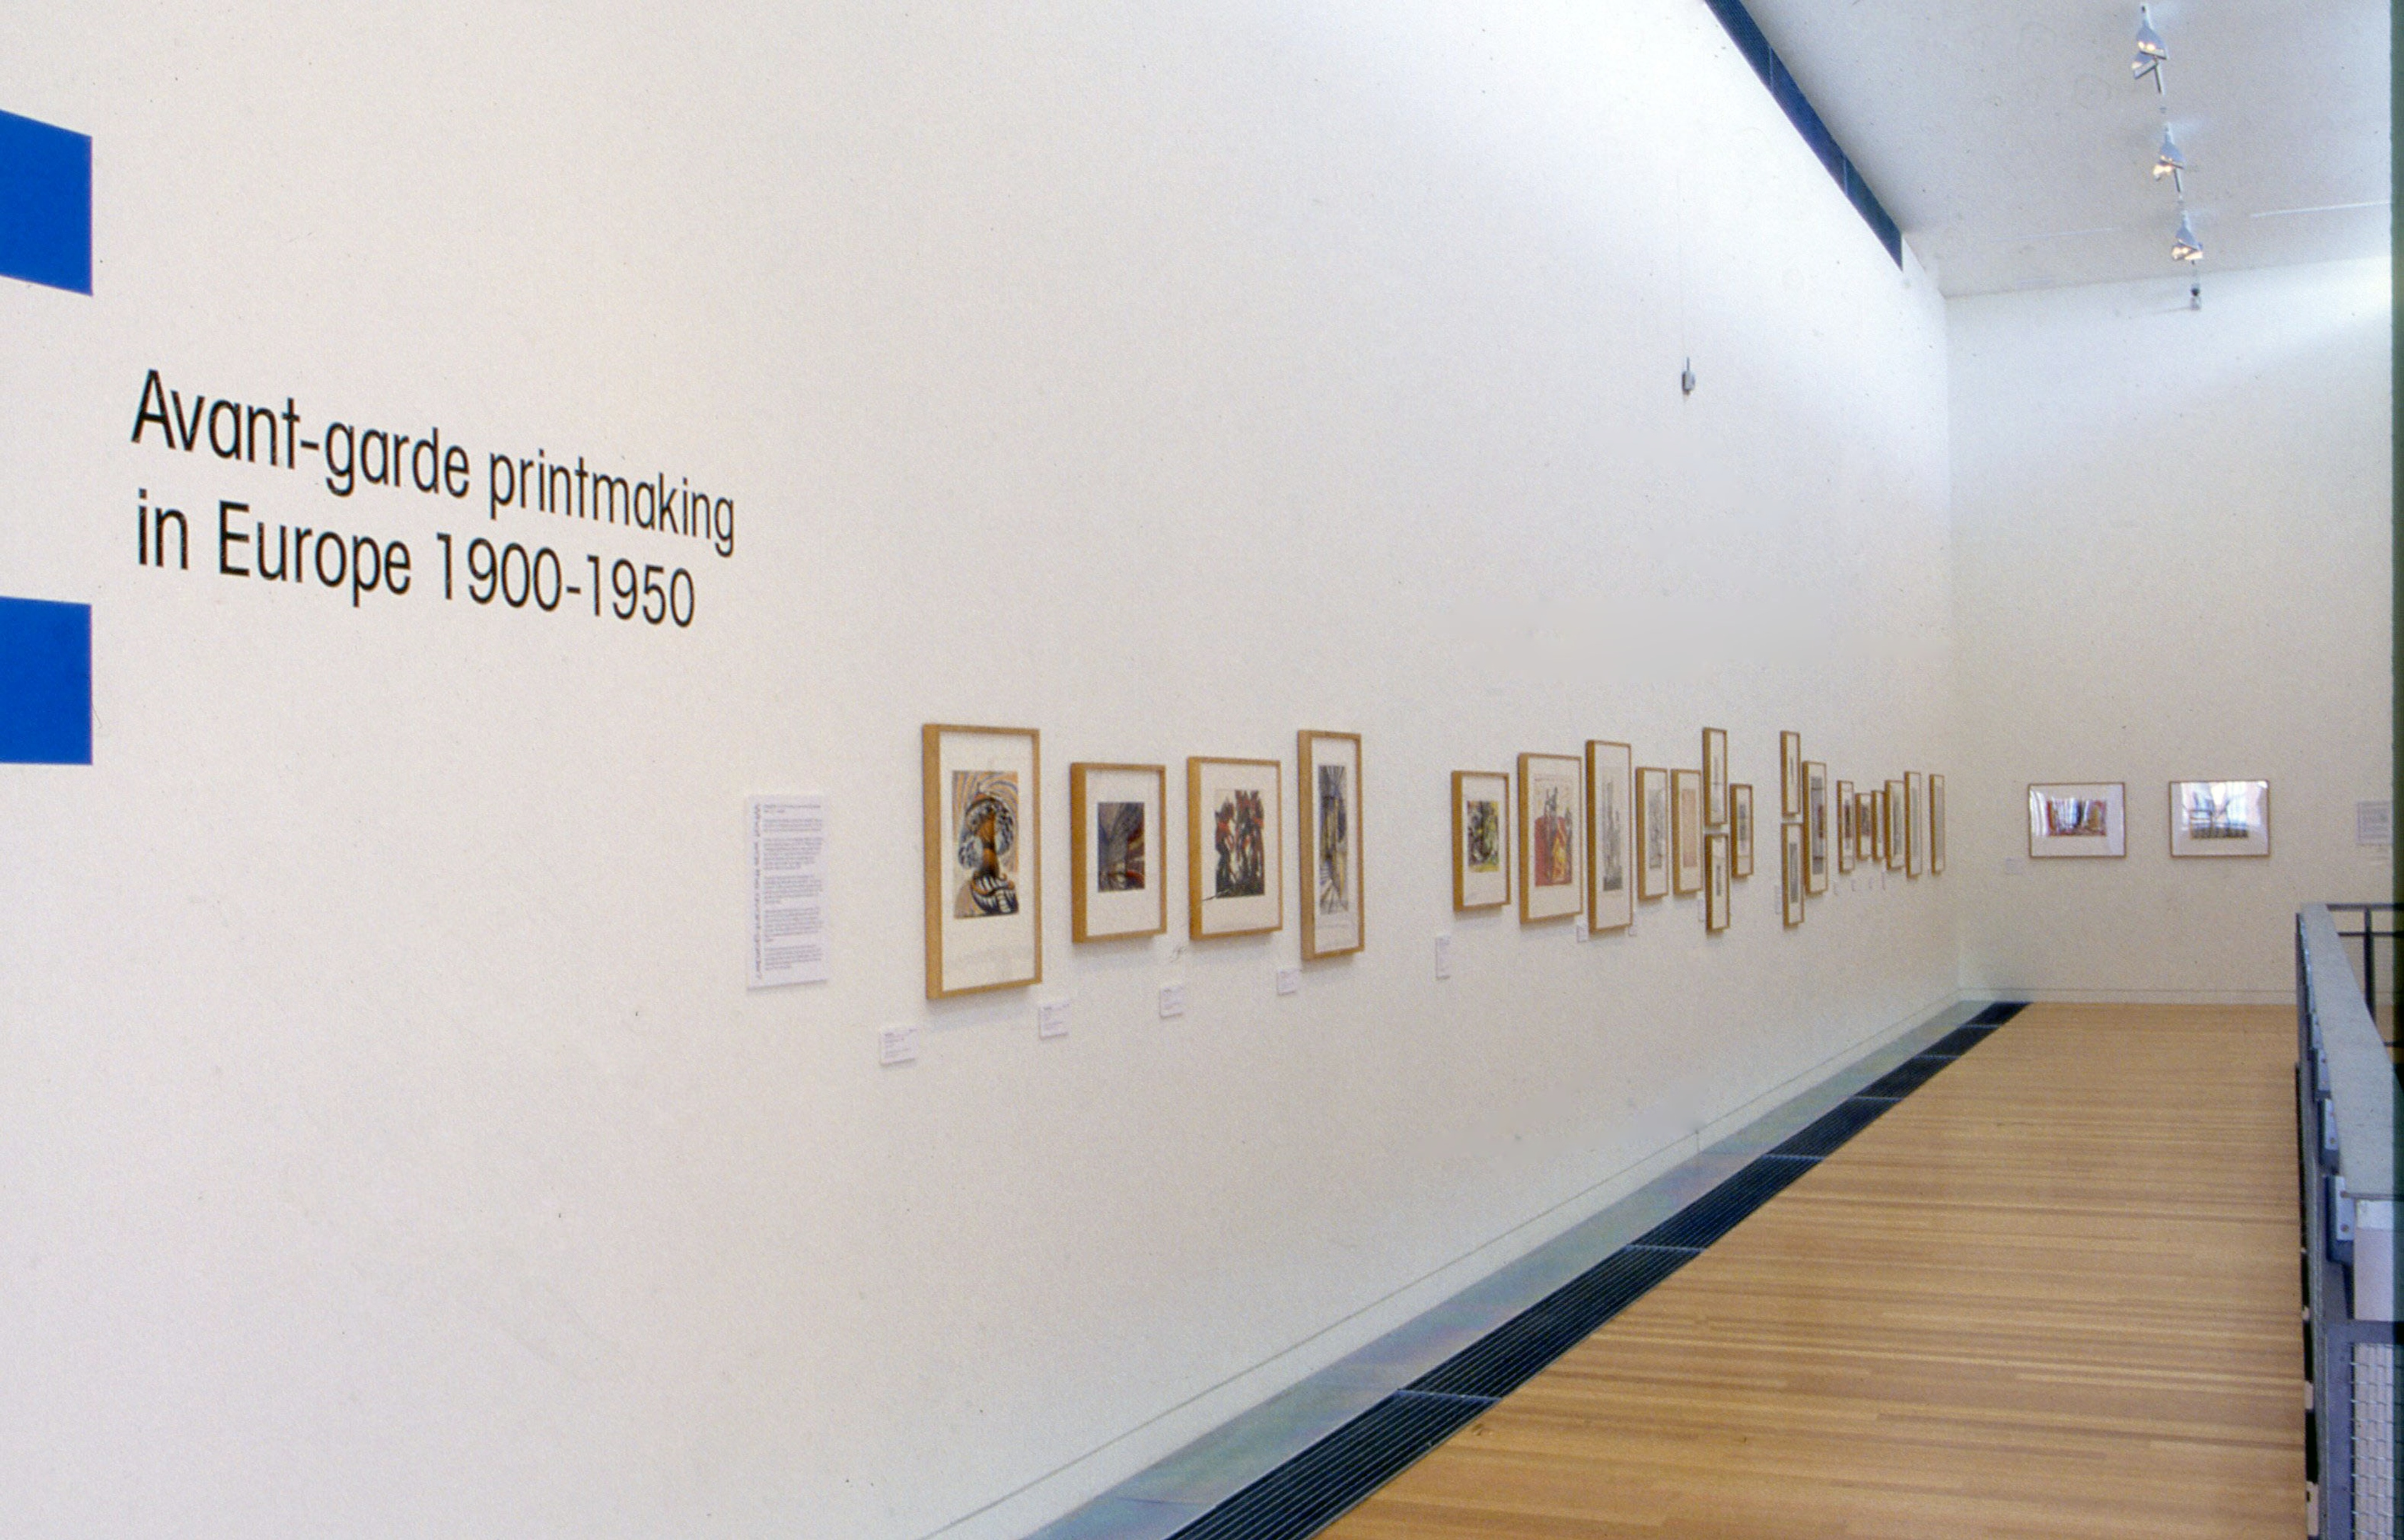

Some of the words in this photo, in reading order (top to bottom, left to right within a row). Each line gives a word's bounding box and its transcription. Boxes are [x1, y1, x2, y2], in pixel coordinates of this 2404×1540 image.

[131, 369, 470, 498] Avant-garde
[490, 449, 734, 558] printmaking
[138, 488, 188, 570] in
[219, 500, 411, 608] Europe
[436, 532, 695, 628] 1900-1950
